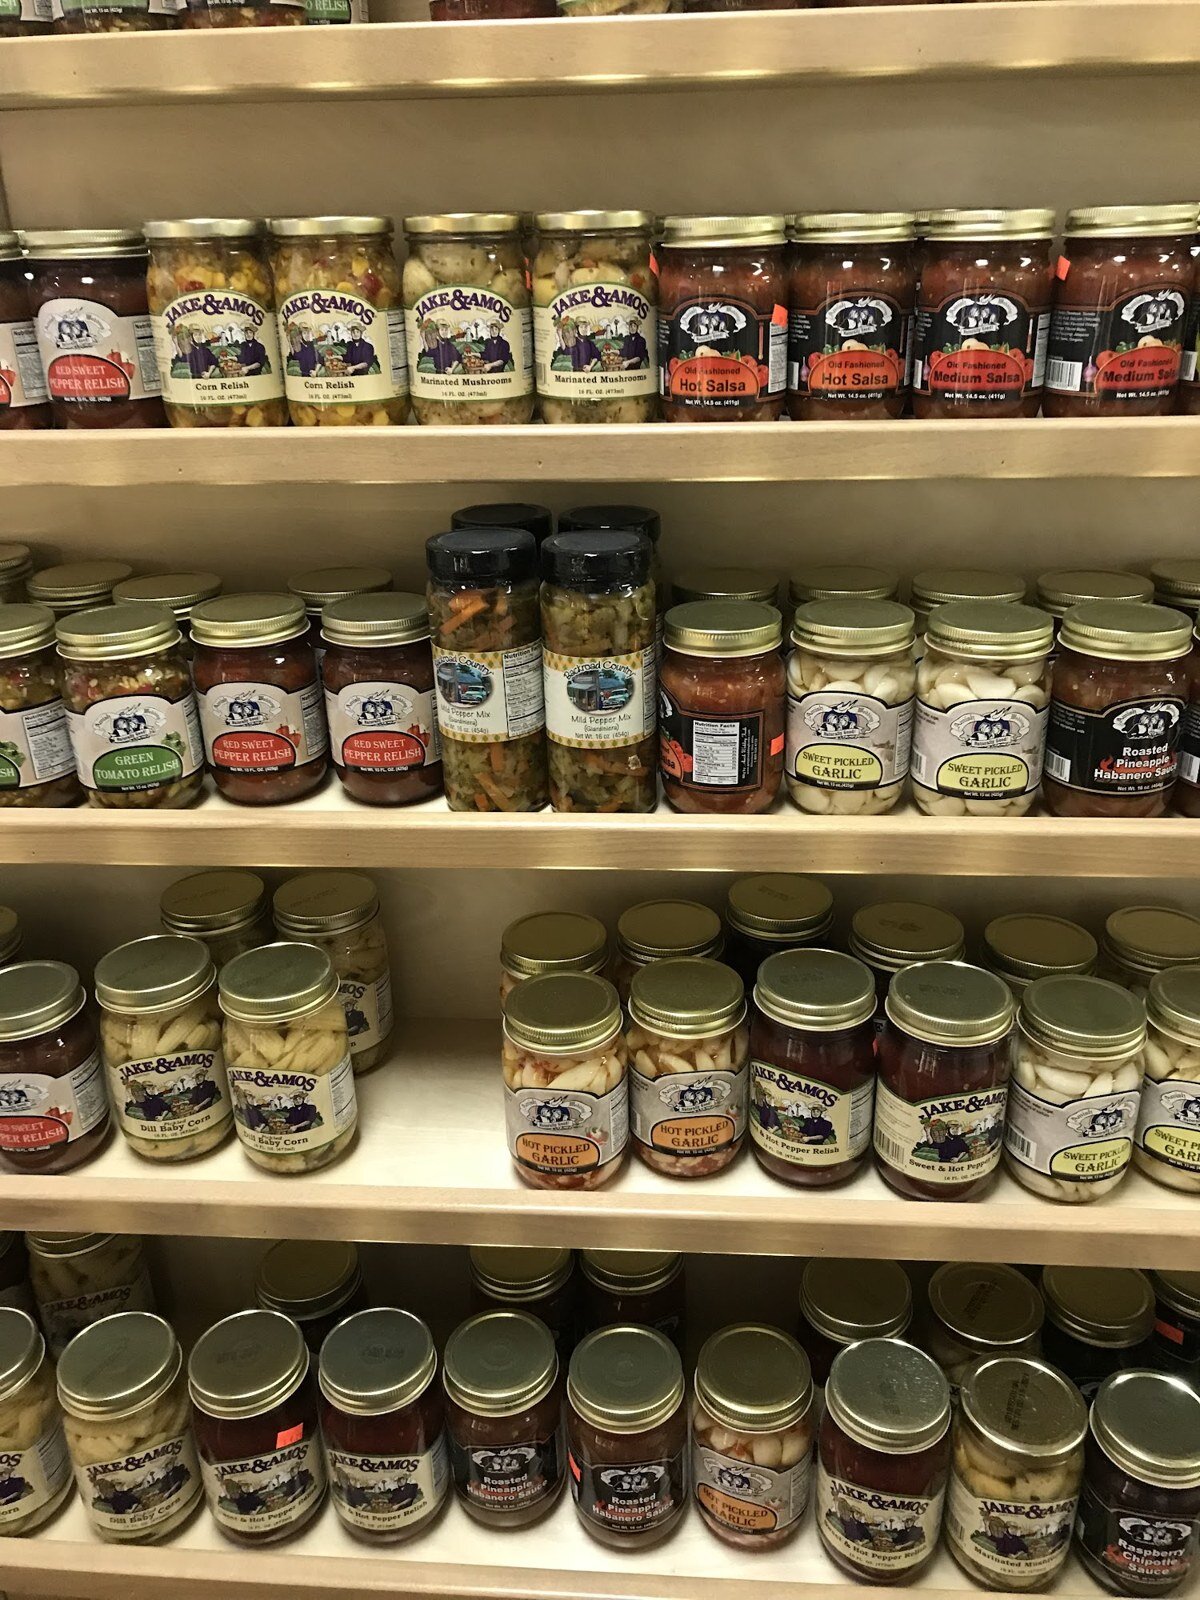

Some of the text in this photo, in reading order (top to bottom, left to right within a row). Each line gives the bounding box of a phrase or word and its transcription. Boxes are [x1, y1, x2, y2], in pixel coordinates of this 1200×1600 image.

[73, 366, 105, 376] SWEET
[698, 366, 740, 374] ashioned
[1120, 360, 1134, 368] Old
[420, 377, 512, 386] Marinated Mushrooms
[554, 374, 647, 384] Marinated Mushrooms
[822, 373, 889, 385] Hot Salsa
[934, 370, 1020, 384] Medium Salsa
[1103, 371, 1154, 382] Medium
[84, 378, 126, 390] RELISH
[220, 382, 249, 390] Relish
[304, 381, 354, 389] Corn Relish
[680, 378, 746, 392] Hot Salsa
[564, 660, 636, 679] Backroad Country
[476, 710, 491, 718] Mix
[571, 714, 631, 725] Mild Pepper Mix
[223, 739, 274, 750] RED SWEET
[354, 739, 406, 749] RED SWEET
[1122, 743, 1168, 757] Roasted
[114, 752, 154, 766] GREEN
[214, 748, 292, 762] PEPPER RELISH
[344, 748, 421, 762] PEPPER RELISH
[802, 751, 874, 767] SWEET PICKLED
[1116, 755, 1170, 769] Pineapple
[94, 758, 180, 780] TOMATO RELISH
[812, 765, 862, 780] GARLIC
[948, 762, 1023, 776] SWEET PICKLED
[1094, 768, 1152, 780] Habanero
[959, 776, 1012, 788] GARLIC
[160, 1124, 184, 1134] Baby
[188, 1114, 211, 1127] Corn
[660, 1120, 729, 1136] HOT PICKLED
[23, 1126, 64, 1143] RELISH
[672, 1134, 719, 1148] GARLIC
[1154, 1128, 1189, 1147] SWEET
[258, 1138, 281, 1148] Baby
[284, 1138, 308, 1146] Corn
[522, 1138, 590, 1154] HOT PICKLED
[780, 1142, 811, 1154] Pepper
[812, 1147, 840, 1155] Relish
[532, 1152, 580, 1166] GARLIC
[1063, 1151, 1098, 1161] SWEET
[908, 1159, 936, 1171] Sweet
[1075, 1156, 1120, 1173] GARLIC
[484, 1473, 528, 1486] Roasted
[466, 1480, 548, 1502] Habanero Sauce
[481, 1482, 532, 1494] Pineapple
[612, 1493, 656, 1506] Roasted
[268, 1505, 296, 1520] Pepper
[356, 1512, 370, 1520] Hot
[404, 1502, 428, 1517] Relish
[592, 1500, 674, 1522] Habanero Sauce
[608, 1502, 660, 1514] Pineapple
[710, 1503, 756, 1527] GARLIC
[722, 1502, 768, 1518] PICKLED
[853, 1546, 868, 1556] Hot
[872, 1552, 902, 1562] Pepper
[1118, 1538, 1186, 1557] Raspberry
[974, 1546, 1021, 1568] Marinated
[1122, 1551, 1178, 1566] Chipotle
[1128, 1562, 1170, 1576] Sauce
